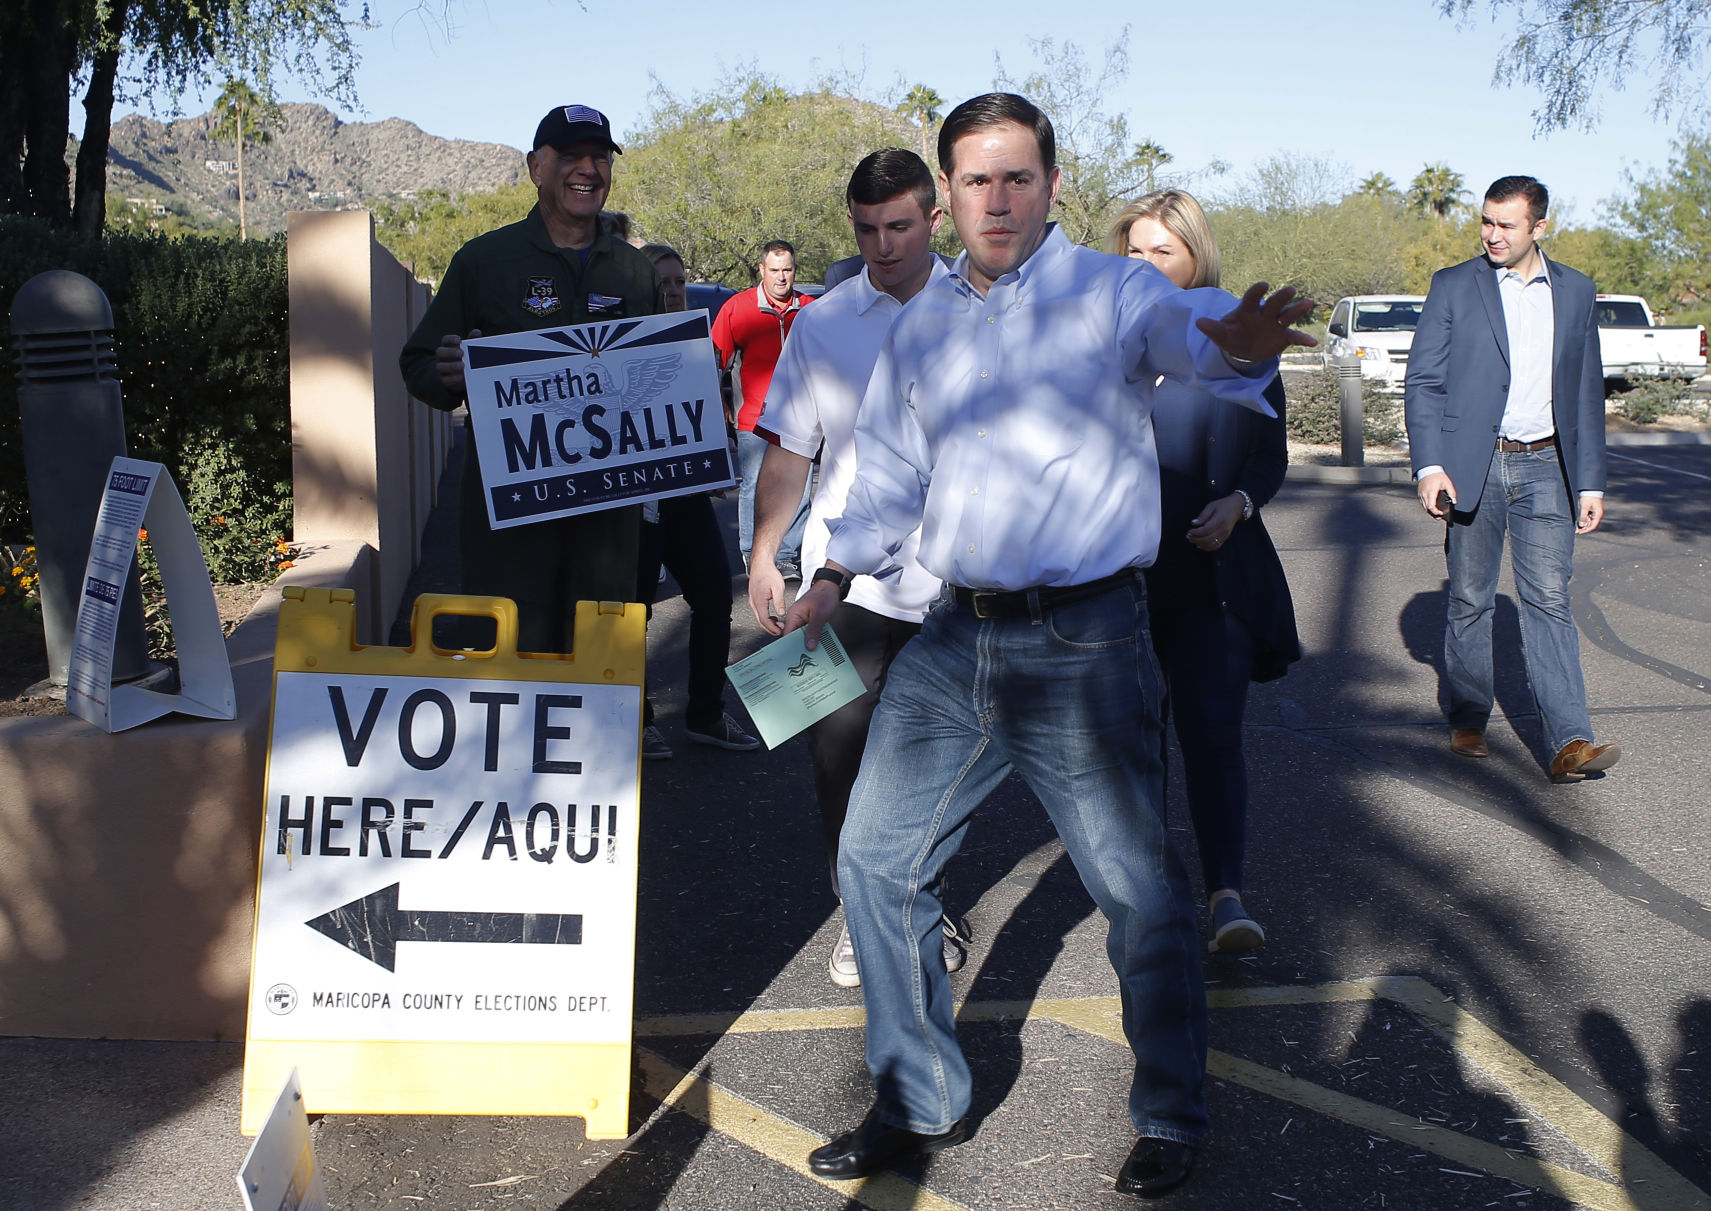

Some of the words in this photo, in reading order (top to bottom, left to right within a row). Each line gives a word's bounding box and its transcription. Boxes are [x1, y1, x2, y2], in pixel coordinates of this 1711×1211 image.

[531, 287, 553, 296] L-39
[494, 368, 603, 409] Martha
[118, 476, 134, 489] FOOT
[534, 479, 587, 501] U.S.
[604, 461, 693, 490] SENATE
[327, 685, 583, 774] VOTE
[277, 794, 618, 865] HERE/AQUI
[312, 991, 391, 1009] MARICOPA
[402, 993, 464, 1010] COUNTY
[474, 994, 557, 1011] ELECTIONS
[568, 996, 611, 1013] DEPT.
